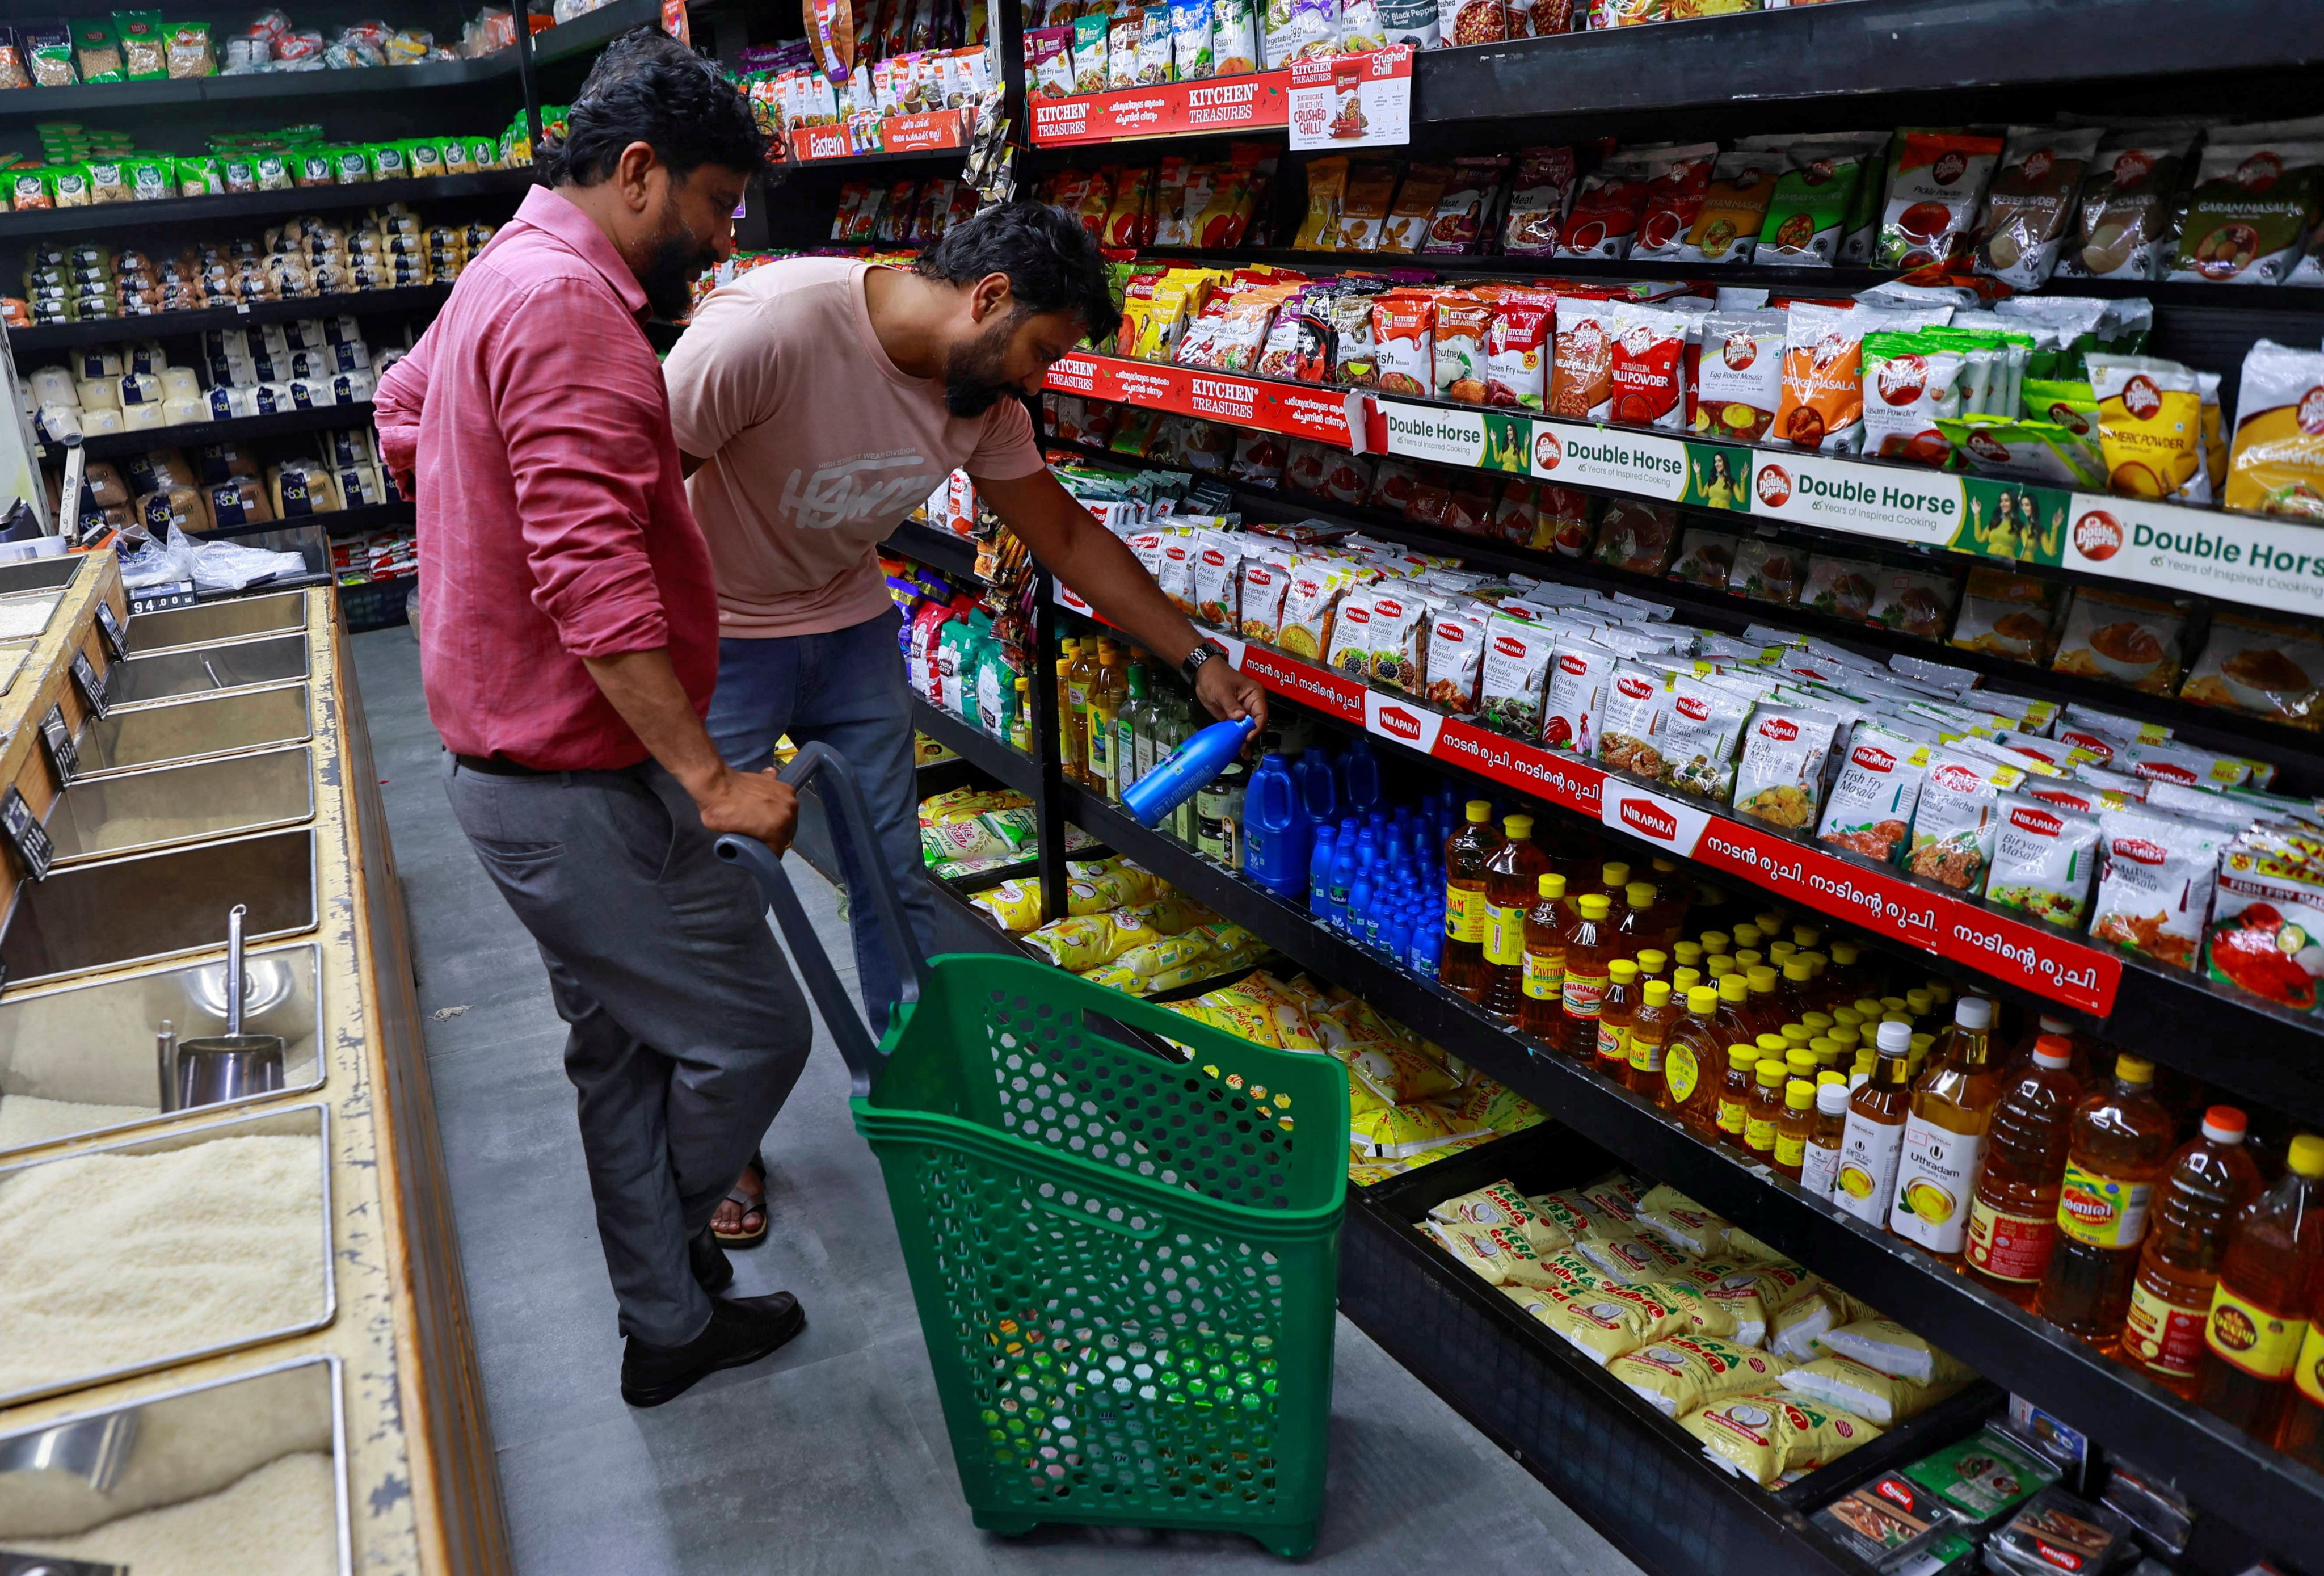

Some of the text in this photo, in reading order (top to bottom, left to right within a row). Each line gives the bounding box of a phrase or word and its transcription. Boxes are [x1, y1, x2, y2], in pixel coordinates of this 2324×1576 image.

[1392, 5, 1439, 20] Black Pepper
[1372, 50, 1407, 65] Crushed
[1037, 67, 1046, 76] Fish
[1292, 62, 1332, 75] KITCHEN
[1372, 62, 1392, 77] Chilli
[1292, 73, 1332, 85] TREASURES
[1190, 103, 1253, 124] TREASURES
[1294, 108, 1327, 123] CRUSHED
[1037, 121, 1087, 137] TREASURES
[1299, 121, 1321, 135] CHILLI
[810, 134, 846, 157] Eastern
[1511, 194, 1533, 205] Meat
[1725, 342, 1753, 358] Double
[1731, 350, 1755, 365] Horse
[1525, 354, 1536, 364] 30
[1505, 365, 1516, 376] Fry
[1621, 362, 1650, 373] PREMIUM
[1047, 372, 1093, 390] TREASURES
[1628, 371, 1669, 388] POWDER
[1710, 371, 1762, 381] Egg Roast Masala
[1818, 379, 1856, 392] MASALA
[1192, 396, 1253, 419] TREASURES
[1887, 408, 1917, 418] Powder
[1389, 415, 1481, 445] Double Horse
[1404, 437, 1471, 456] Years of Inspired Cooking
[2141, 433, 2184, 451] POWDER
[1536, 444, 1560, 456] Double
[1542, 451, 1561, 460] Horse
[1567, 440, 1683, 475] Double Horse
[819, 447, 916, 470] HIGH STREET WEAR DIVISION
[1588, 463, 1670, 488] Years of Inspired Cooking
[1759, 478, 1788, 490] Double
[1765, 486, 1791, 497] Horse
[1799, 474, 1955, 516] Double Horse
[1824, 502, 1937, 531] Years of Inspired Cooking
[2078, 527, 2119, 543] Double
[2085, 536, 2119, 550] Horse
[2133, 523, 2241, 563] Double
[1203, 553, 1224, 565] NIRAPARA
[1164, 568, 1180, 577] Powder
[1197, 573, 1218, 584] Powder
[1198, 566, 1216, 576] Pickle
[2167, 557, 2323, 597] Years of Inspired Cooking
[1244, 591, 1263, 602] Masala
[1245, 585, 1270, 596] Vegetable
[134, 596, 178, 613] 94.00
[1375, 603, 1400, 615] NIRAPARA
[1346, 610, 1369, 621] NIRAPARA
[1371, 617, 1392, 628] Garam
[1337, 629, 1358, 641] Masala
[1369, 624, 1392, 636] Masala
[1438, 625, 1462, 639] NIRAPARA
[1433, 641, 1450, 651] Meat
[1497, 640, 1526, 655] NIRAPARA
[1431, 648, 1454, 661] Masala
[1489, 655, 1508, 666] Meat
[938, 660, 953, 670] INDIA
[938, 666, 950, 675] GATE
[1487, 664, 1511, 677] Masala
[1561, 659, 1586, 673] NIRAPARA
[1247, 657, 1363, 712] നാടൻ രുചി, നാടിന്റെ രുചി.
[1554, 674, 1579, 690] Chicken
[1552, 683, 1576, 697] Masala
[1607, 705, 1629, 718] Chicken
[2025, 713, 2045, 724] NEW
[1382, 712, 1419, 735] NIRAPARA
[1666, 724, 1691, 738] Masala
[1669, 717, 1719, 740] Pepper Chicken
[1752, 741, 1771, 753] Fish
[2138, 734, 2162, 745] NEW
[1749, 750, 1783, 766] Masala
[1854, 750, 1892, 770] NIRAPARA
[1443, 732, 1602, 802] നാടൻ രുചി, നാടിന്റെ രുചി.
[2213, 768, 2235, 779] NEW
[1843, 769, 1884, 791] Fish Fry
[1839, 781, 1877, 801] Masala
[1623, 804, 1675, 836] NIRAPARA
[2013, 810, 2061, 833] NIRAPARA
[958, 821, 975, 839] Rice
[2002, 833, 2048, 854] Biryani
[2115, 840, 2164, 863] NIRAPARA
[1707, 835, 1939, 932] നാടൻ രുചി, നാടിന്റെ രുചി.
[2230, 879, 2294, 901] FISH FRY
[1954, 923, 2102, 993] നാടിന്റെ രുചി.
[1910, 1152, 1960, 1178] Uthradam
[1494, 1185, 1535, 1221] KERA
[2062, 1199, 2112, 1217] ശബരി
[1500, 1226, 1538, 1260] KERA
[1555, 1256, 1597, 1288] KERA
